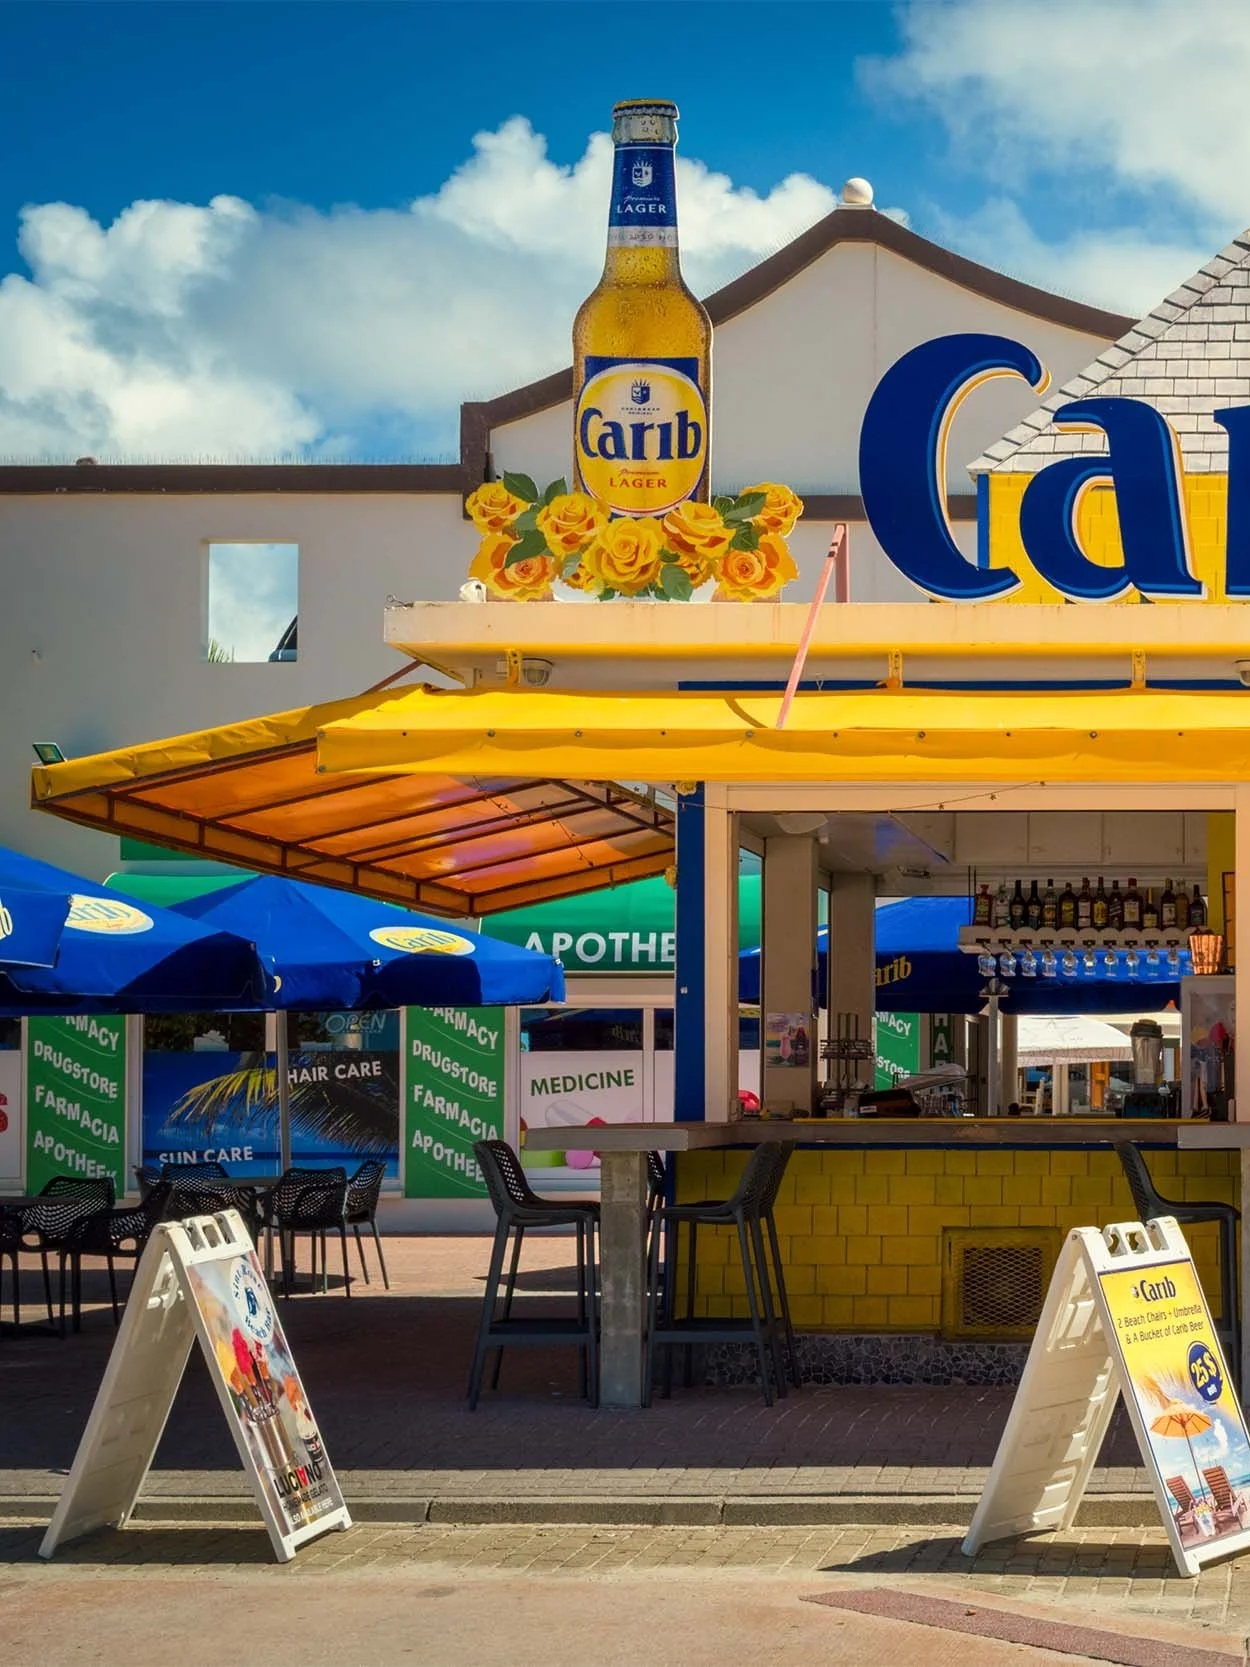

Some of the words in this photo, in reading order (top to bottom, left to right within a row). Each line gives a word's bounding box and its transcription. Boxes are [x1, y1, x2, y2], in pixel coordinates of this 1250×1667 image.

[616, 204, 667, 214] LAGER
[580, 408, 702, 460] Carib
[609, 478, 668, 488] LAGER
[67, 901, 131, 921] arib
[385, 931, 457, 950] Carib
[875, 955, 912, 986] arib
[326, 1013, 387, 1033] OPEN
[34, 1040, 119, 1099] DRUGSTORE
[287, 1064, 329, 1085] HAIR
[335, 1060, 382, 1080] CARE
[412, 1040, 497, 1098] DRUGSTORE
[530, 1069, 635, 1097] MEDICINE
[34, 1085, 120, 1144] FARMACIA
[413, 1085, 499, 1141] FARMACIA
[159, 1151, 197, 1168] SUN
[202, 1147, 254, 1163] CARE
[412, 1129, 486, 1184] APOTHEE
[1139, 1276, 1176, 1302] Carib
[1117, 1318, 1123, 1328] 2
[1124, 1314, 1146, 1328] Beach
[1147, 1311, 1167, 1323] Chairs
[1173, 1304, 1202, 1319] Umbrella
[1126, 1334, 1132, 1345] &
[1133, 1333, 1139, 1343] A
[1140, 1328, 1164, 1342] Bucket
[1165, 1325, 1172, 1337] of
[1172, 1322, 1188, 1335] Carib
[1189, 1320, 1204, 1332] Beer
